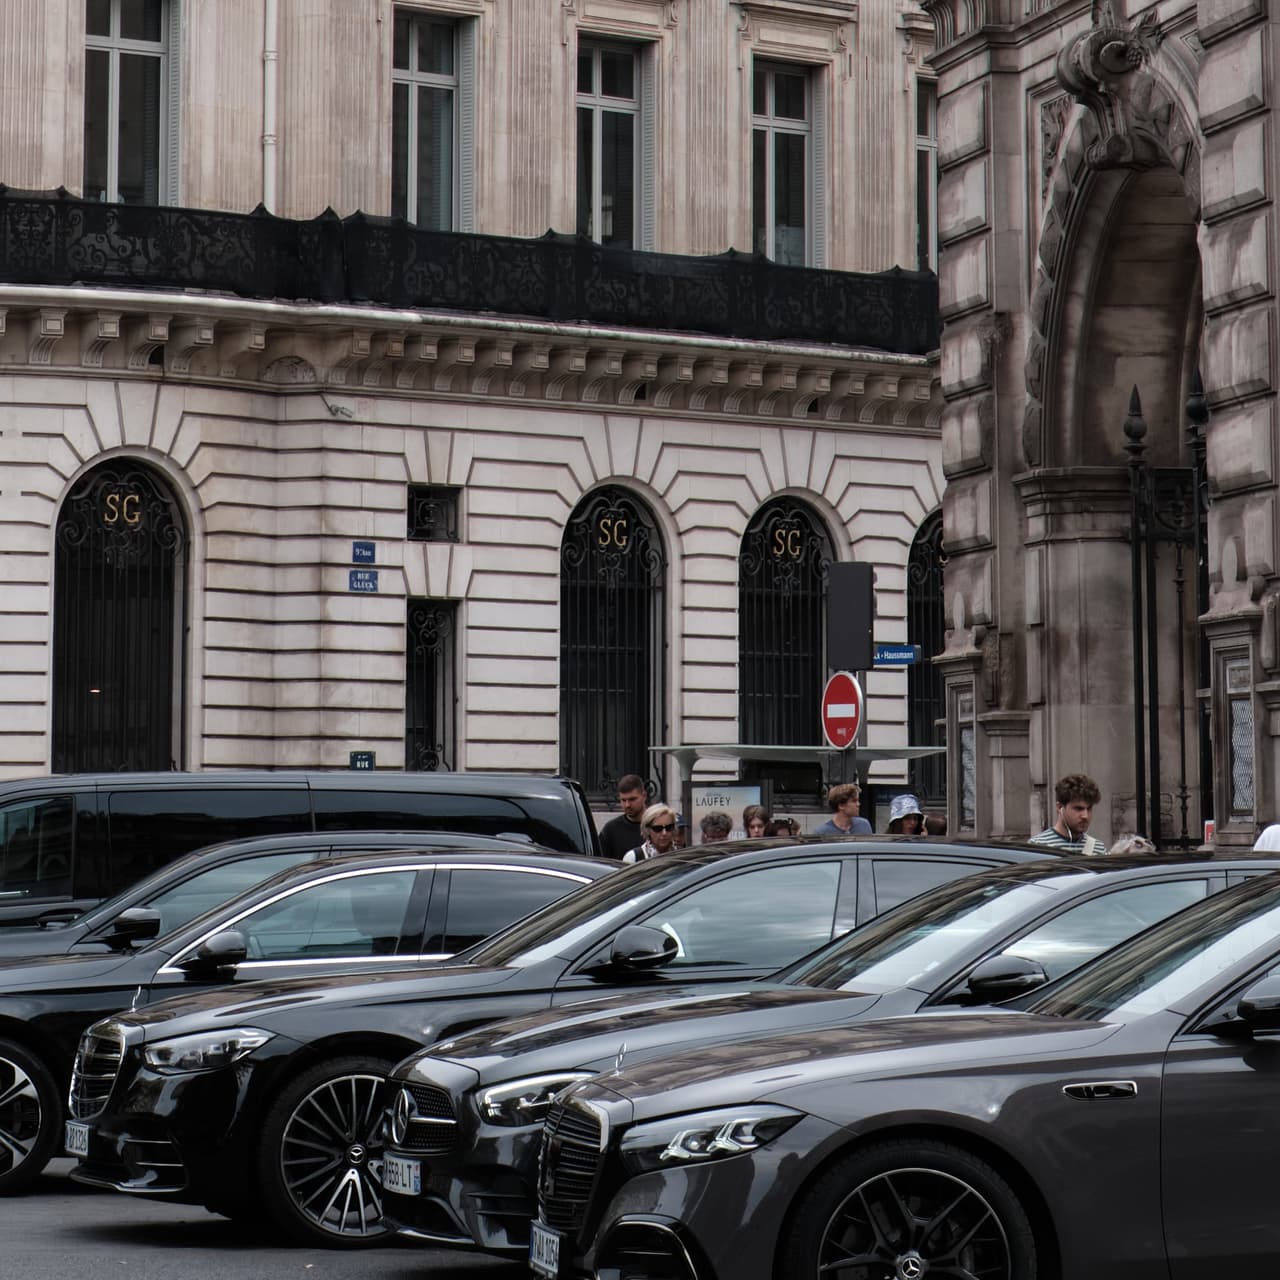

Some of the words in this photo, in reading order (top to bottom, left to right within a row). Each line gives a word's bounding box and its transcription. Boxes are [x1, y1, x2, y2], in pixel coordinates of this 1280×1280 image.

[104, 493, 141, 524] SG
[598, 518, 628, 547] SG
[773, 528, 801, 557] SG
[695, 796, 732, 807] LAUFEY
